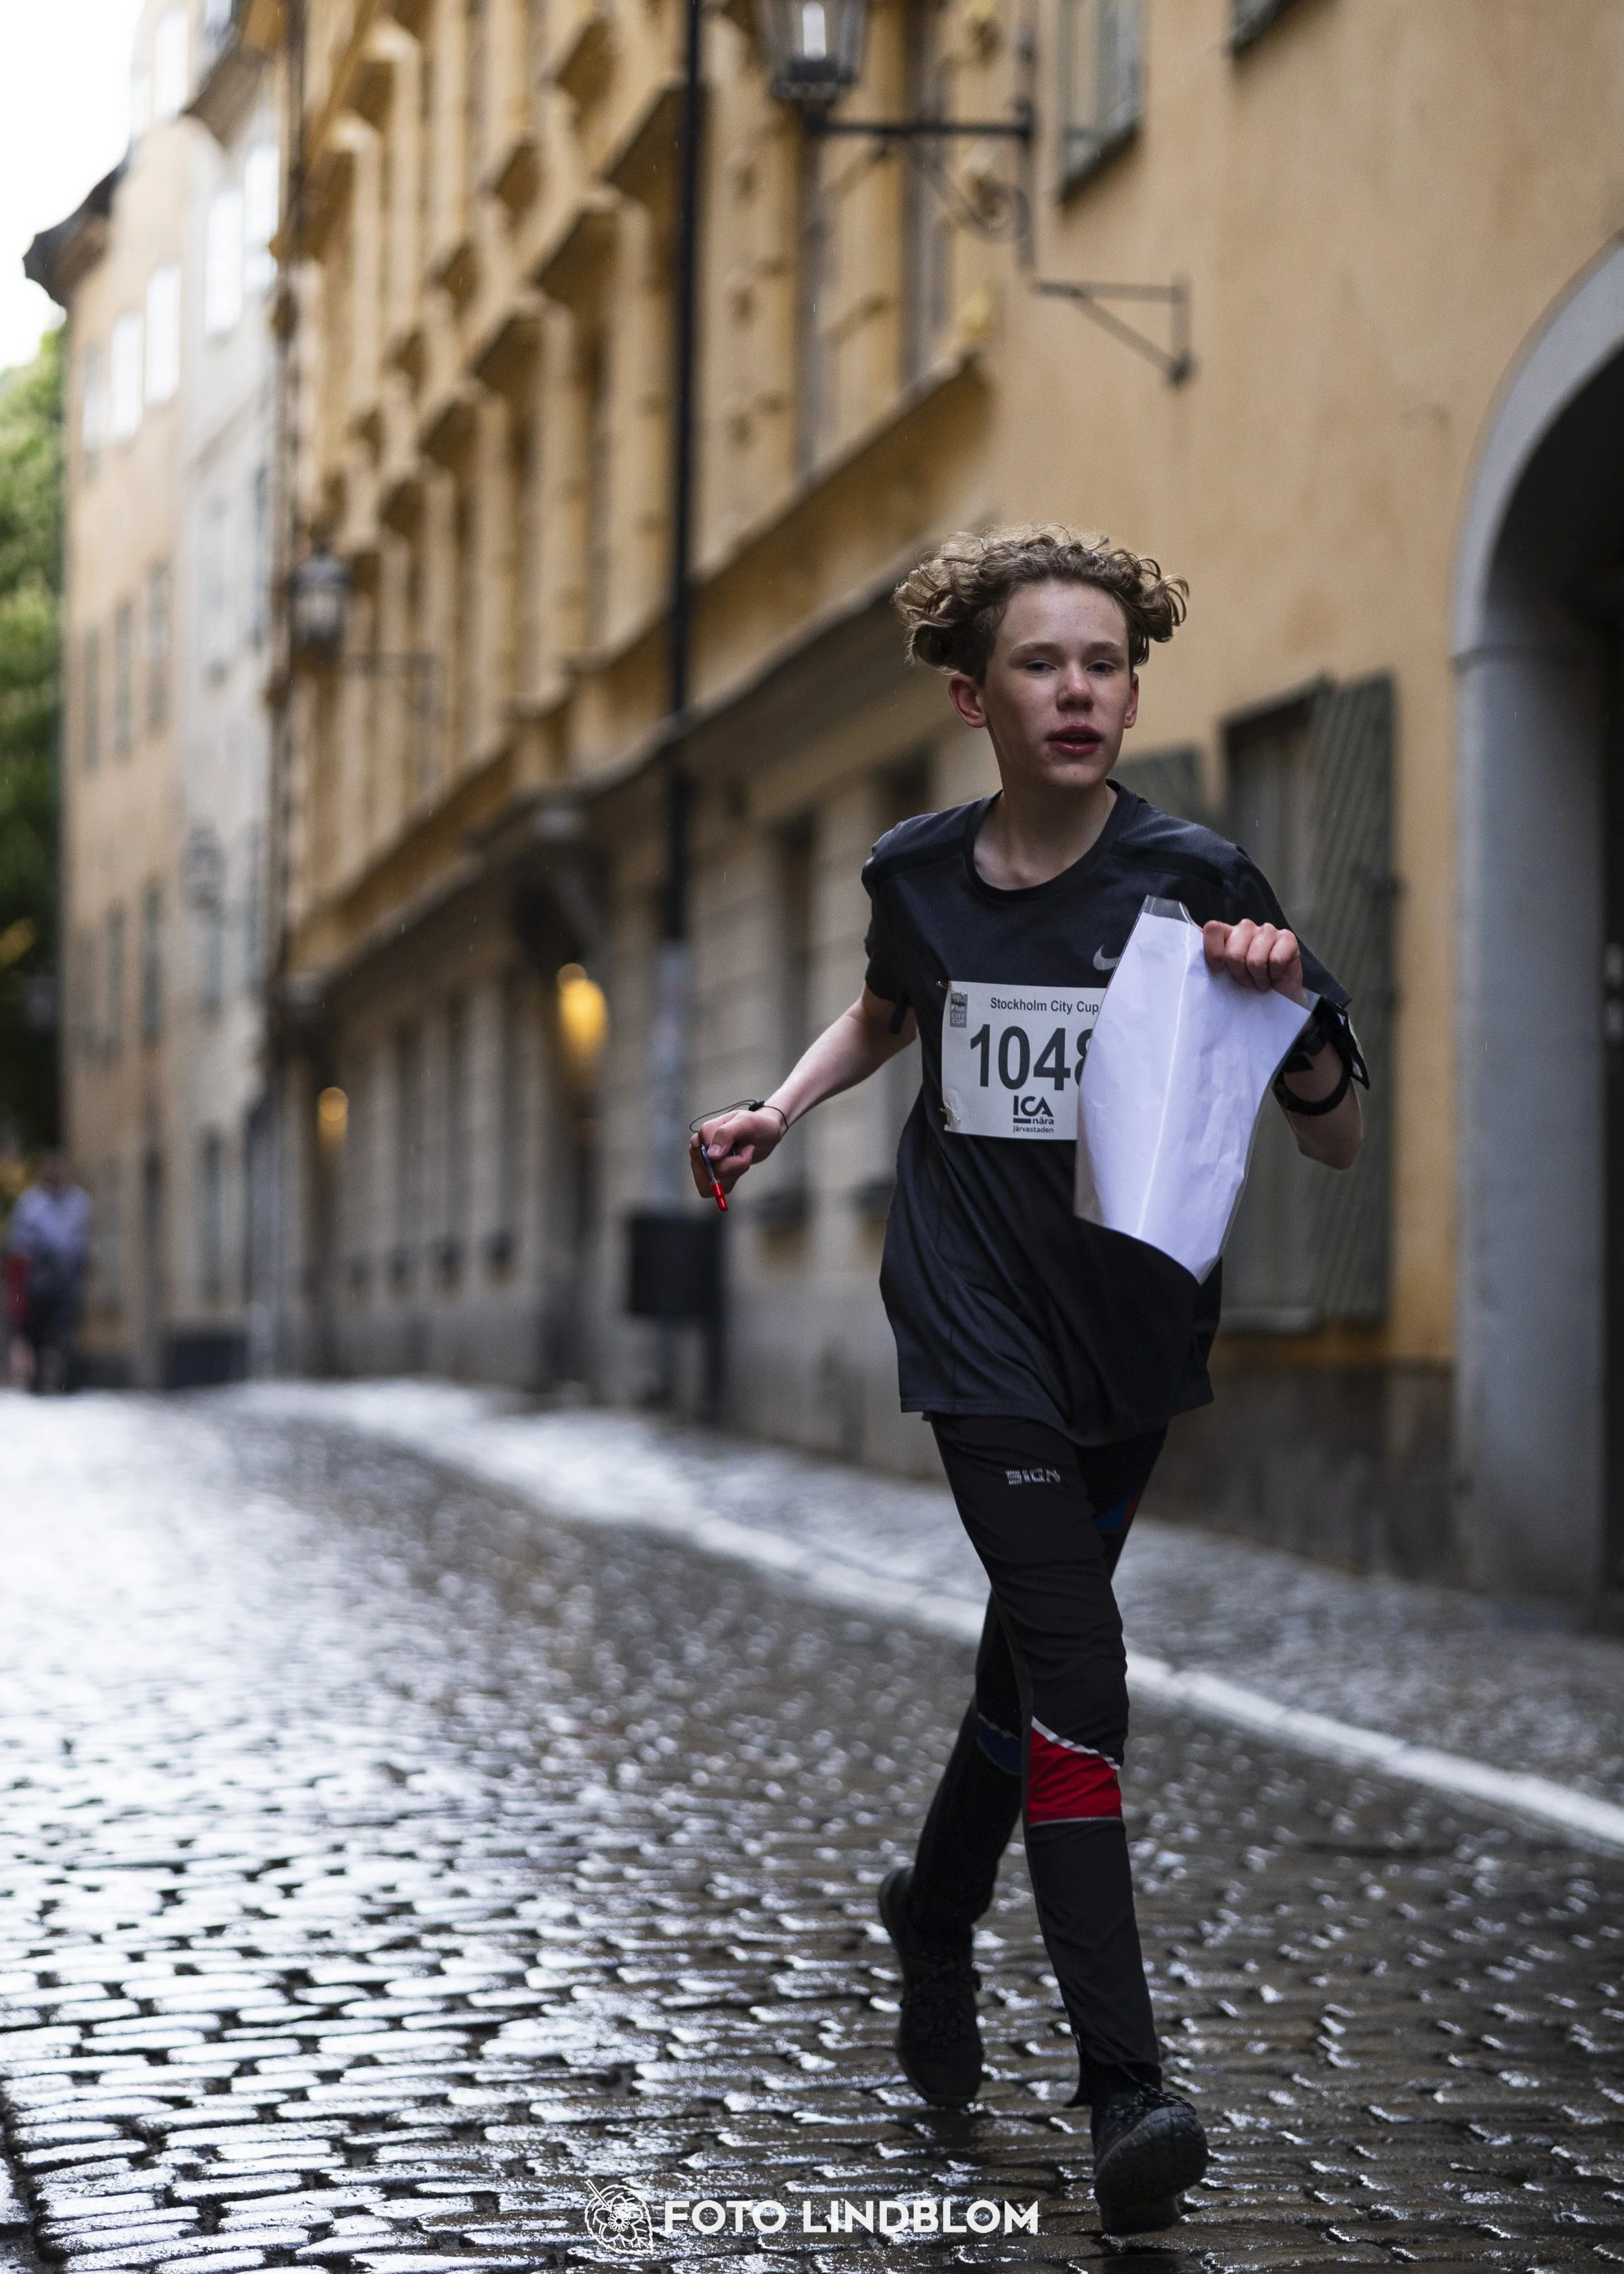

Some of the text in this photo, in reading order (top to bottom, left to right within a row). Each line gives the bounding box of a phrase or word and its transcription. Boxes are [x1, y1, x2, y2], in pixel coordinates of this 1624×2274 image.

[991, 997, 1098, 1014] Stockholm City Cup
[1013, 1095, 1054, 1117] ICA
